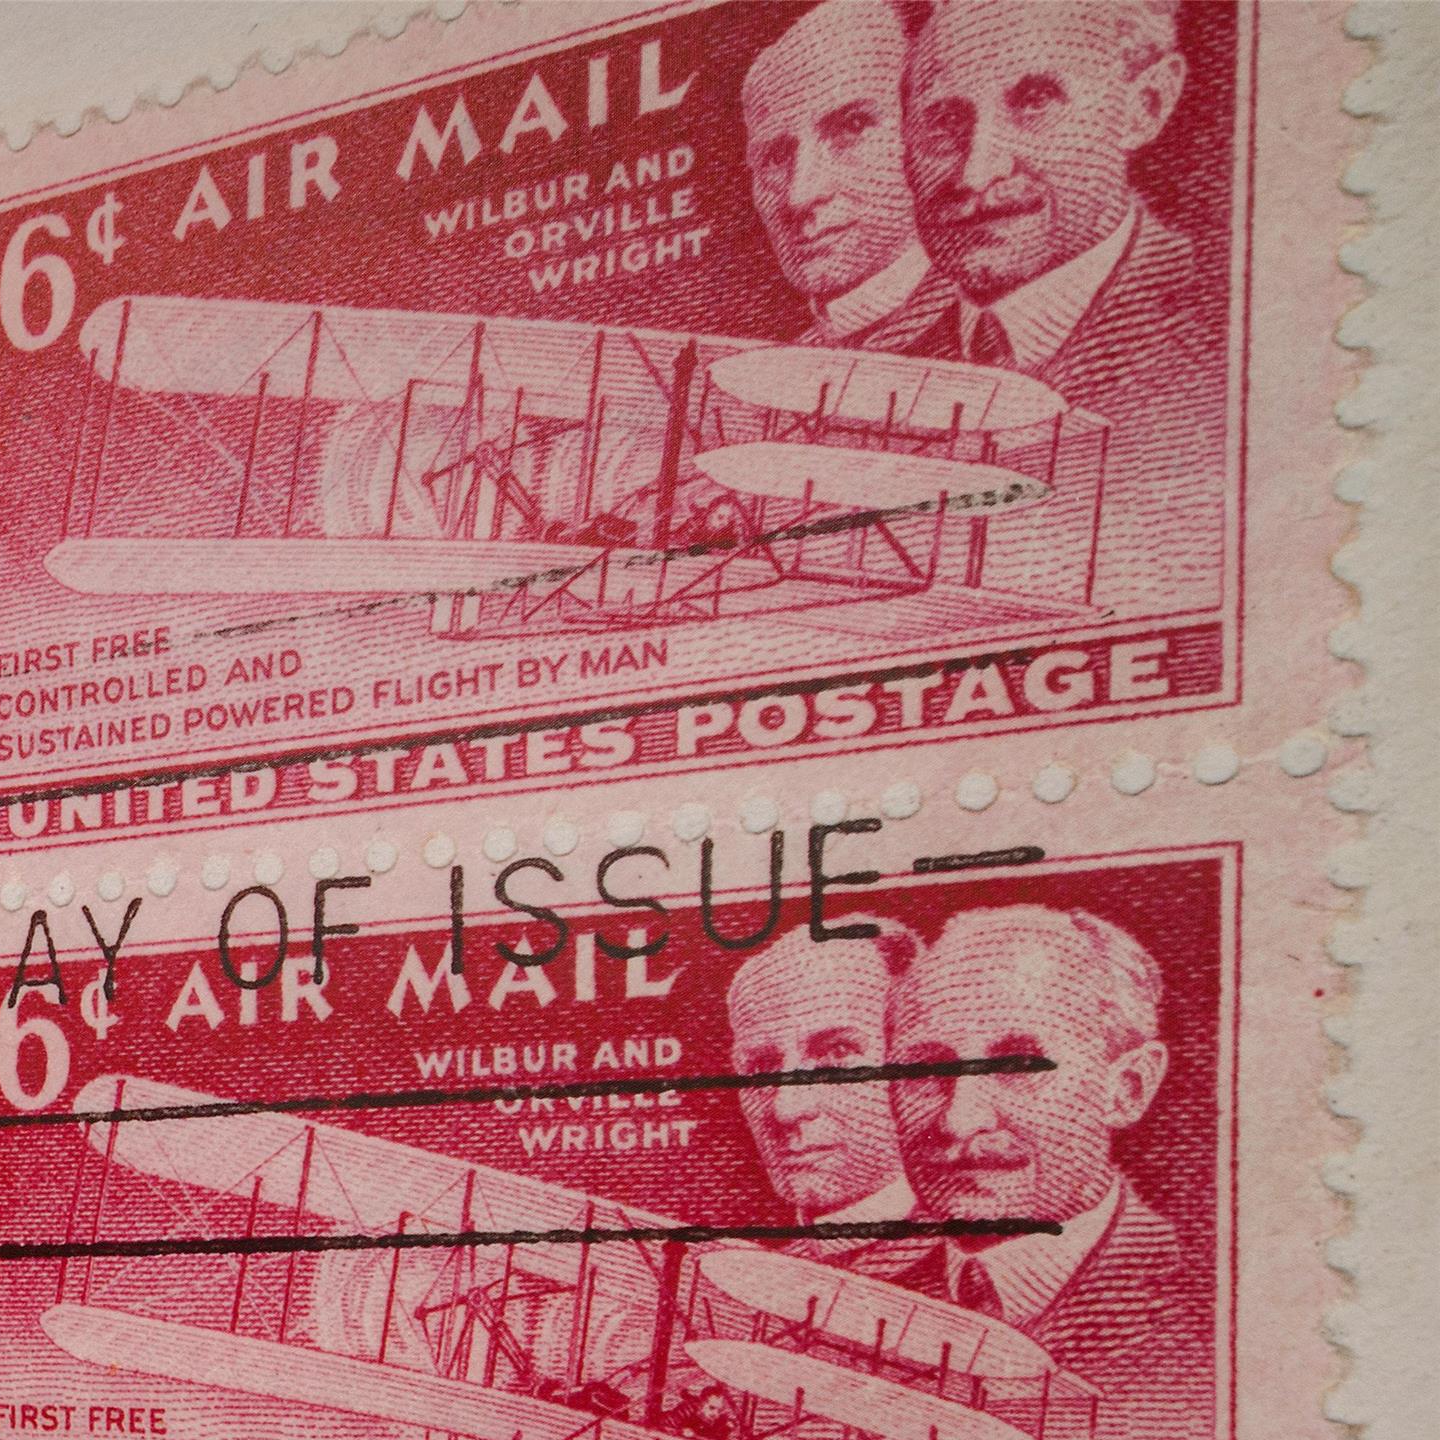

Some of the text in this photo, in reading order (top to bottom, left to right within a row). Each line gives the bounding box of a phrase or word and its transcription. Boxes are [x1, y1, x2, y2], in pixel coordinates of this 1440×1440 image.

[173, 136, 342, 241] AIR
[395, 40, 700, 180] MAIL
[424, 146, 696, 238] WILBUR AND
[504, 189, 696, 260] ORVILLE
[528, 226, 710, 294] WRIGHT
[91, 625, 171, 663] FREE
[224, 649, 303, 684] AND
[184, 686, 355, 737] POWERED
[373, 663, 502, 709] FLIGHT
[520, 654, 570, 688] BY
[579, 638, 670, 679] MAN
[7, 639, 1169, 839] UNITED STATES POSTAGE
[219, 876, 371, 990] OF
[450, 818, 883, 974] ISSUE
[165, 961, 334, 1032] AIR
[386, 929, 687, 1020] MAIL
[416, 1037, 683, 1080] WILBUR AND
[519, 1120, 698, 1156] WRIGHT
[87, 1406, 167, 1436] FREE
